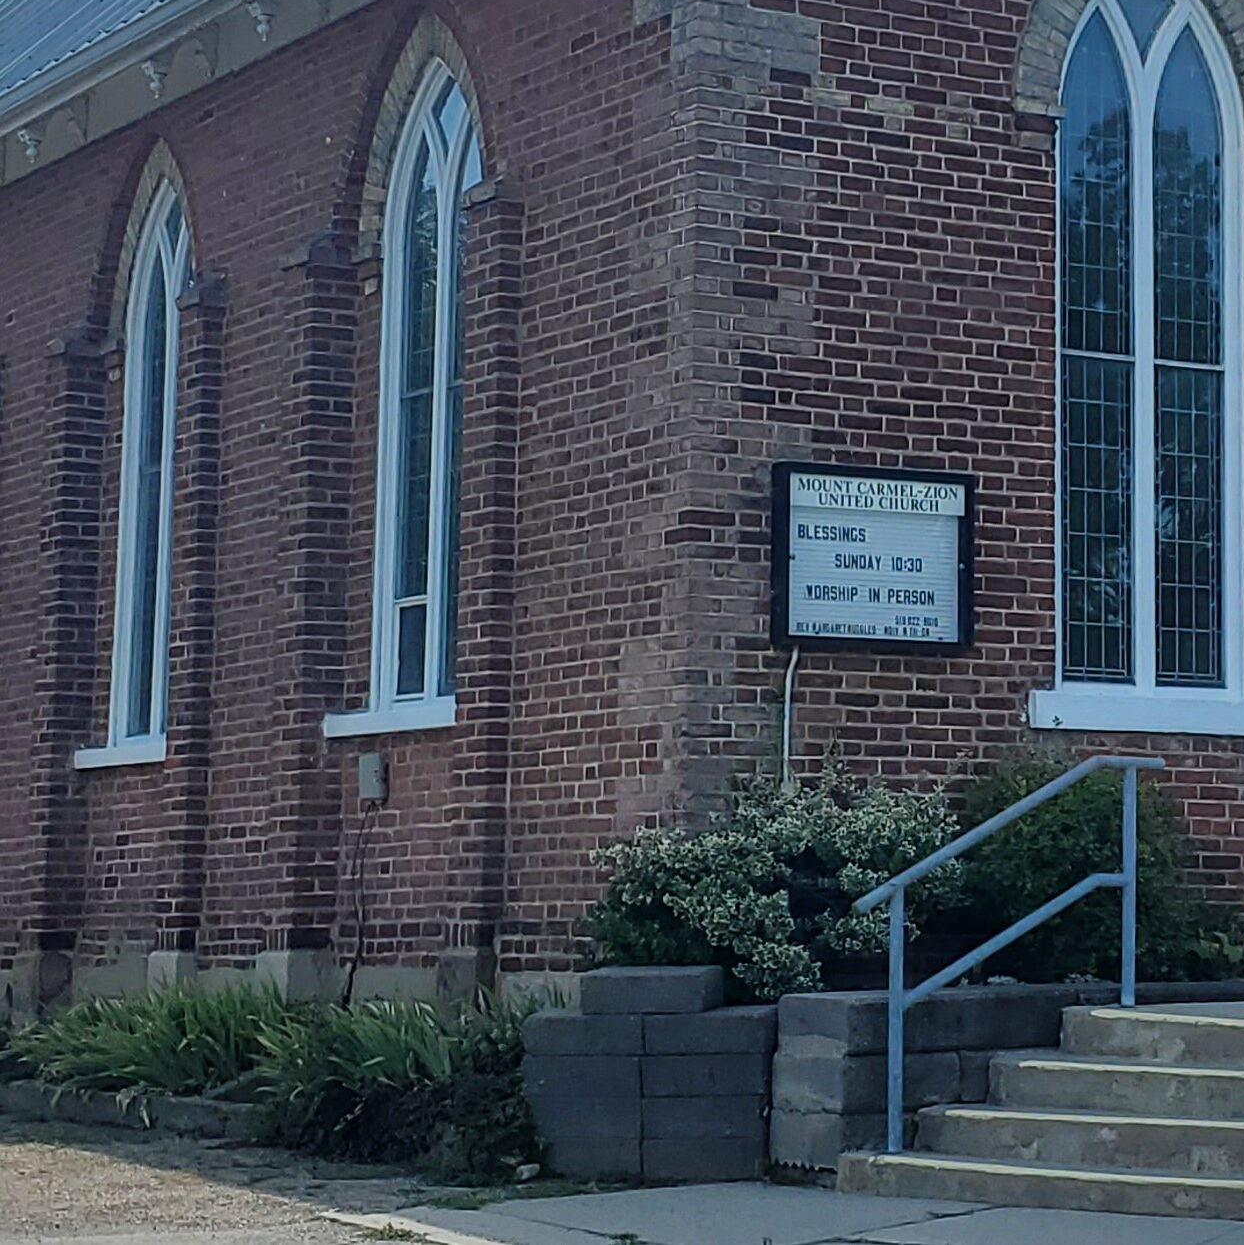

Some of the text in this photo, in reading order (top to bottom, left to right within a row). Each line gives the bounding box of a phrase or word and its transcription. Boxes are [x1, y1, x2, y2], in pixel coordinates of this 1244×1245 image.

[798, 478, 958, 499] MOUNT CARMEL-ZION
[818, 493, 939, 512] UNITED CHURCH
[798, 524, 867, 542] BLESSINGS
[834, 553, 923, 573] SUNDAY 10:30
[805, 584, 935, 605] WORSHIP IN PERSON
